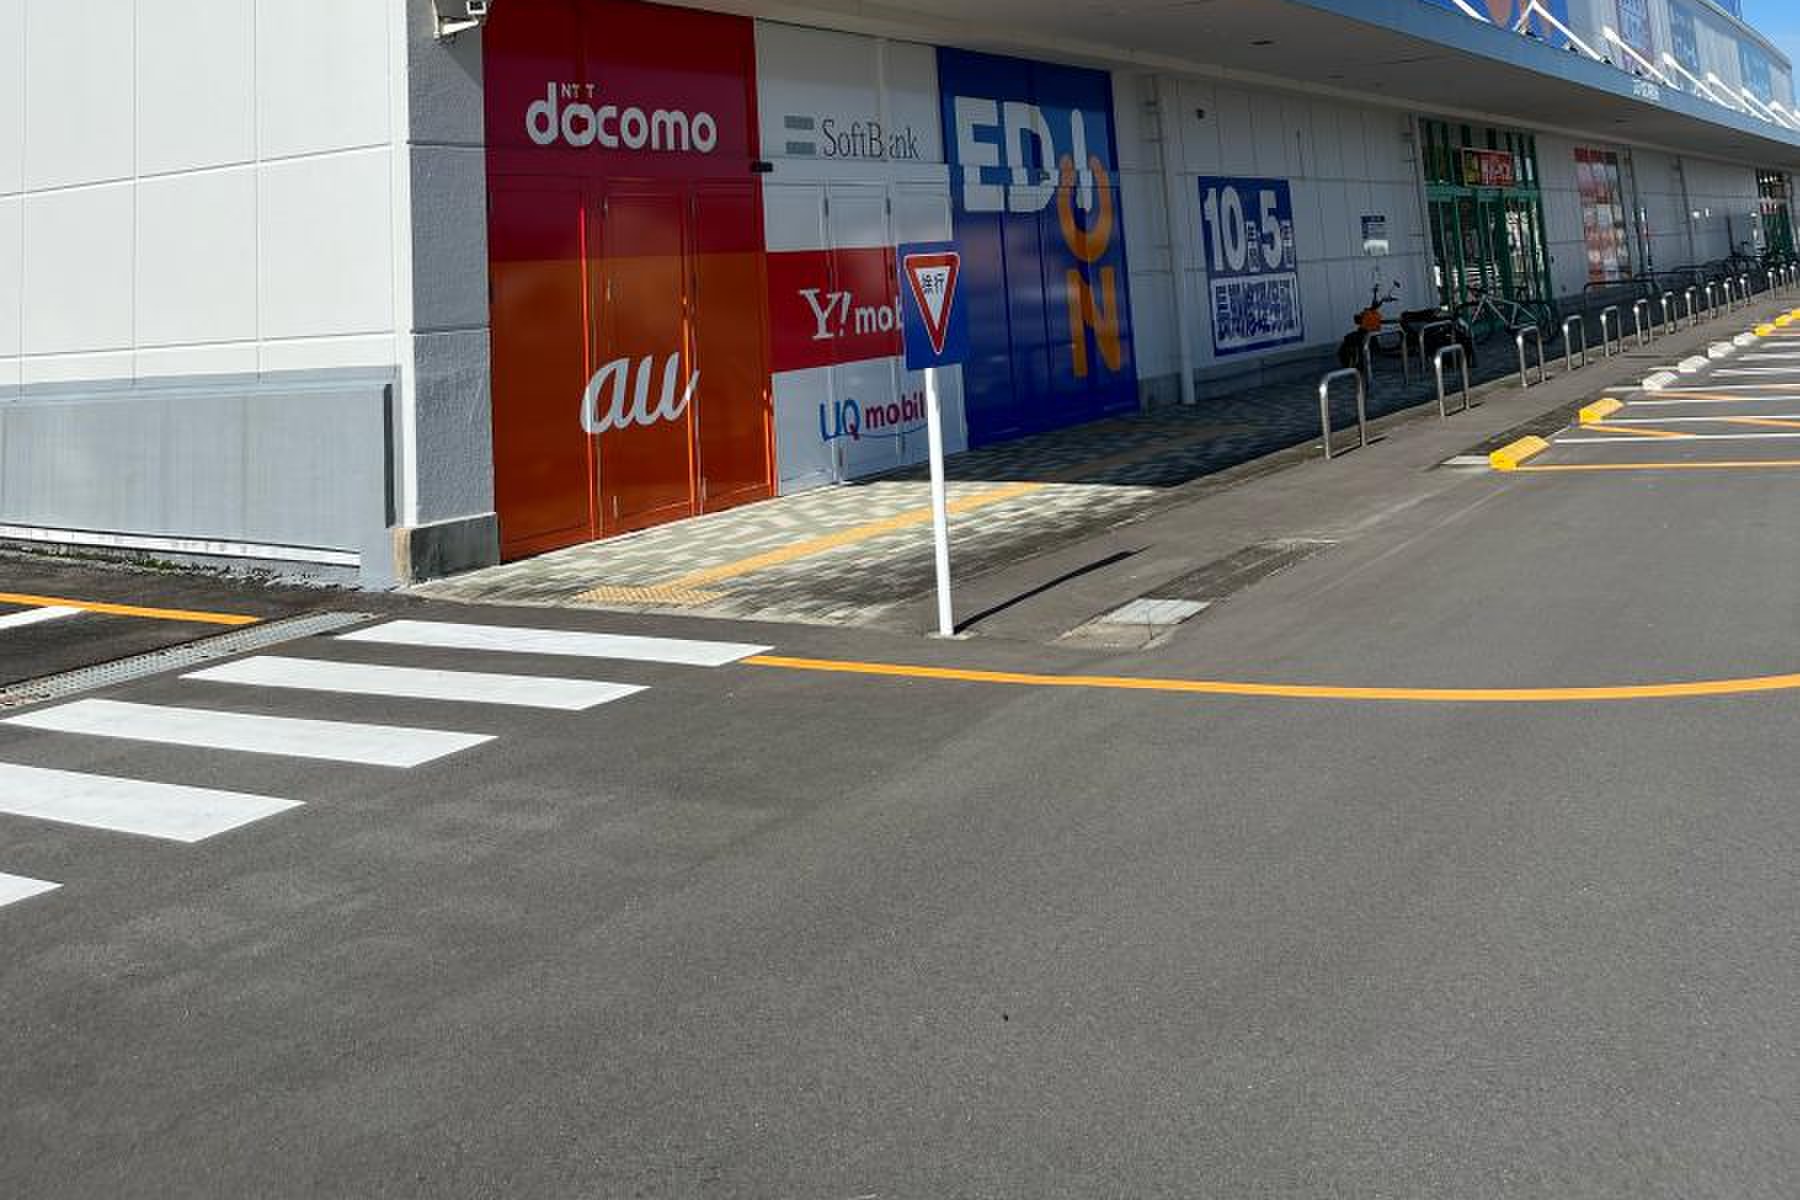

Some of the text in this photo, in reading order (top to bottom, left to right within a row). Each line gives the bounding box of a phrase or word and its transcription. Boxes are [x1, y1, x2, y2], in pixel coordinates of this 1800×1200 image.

[526, 81, 717, 154] docomo
[561, 83, 596, 98] NTT
[822, 119, 920, 160] SoftBank
[954, 96, 1121, 377] EDION
[1204, 185, 1246, 271] 10
[580, 351, 700, 434] au
[819, 390, 927, 441] UQ mobil
